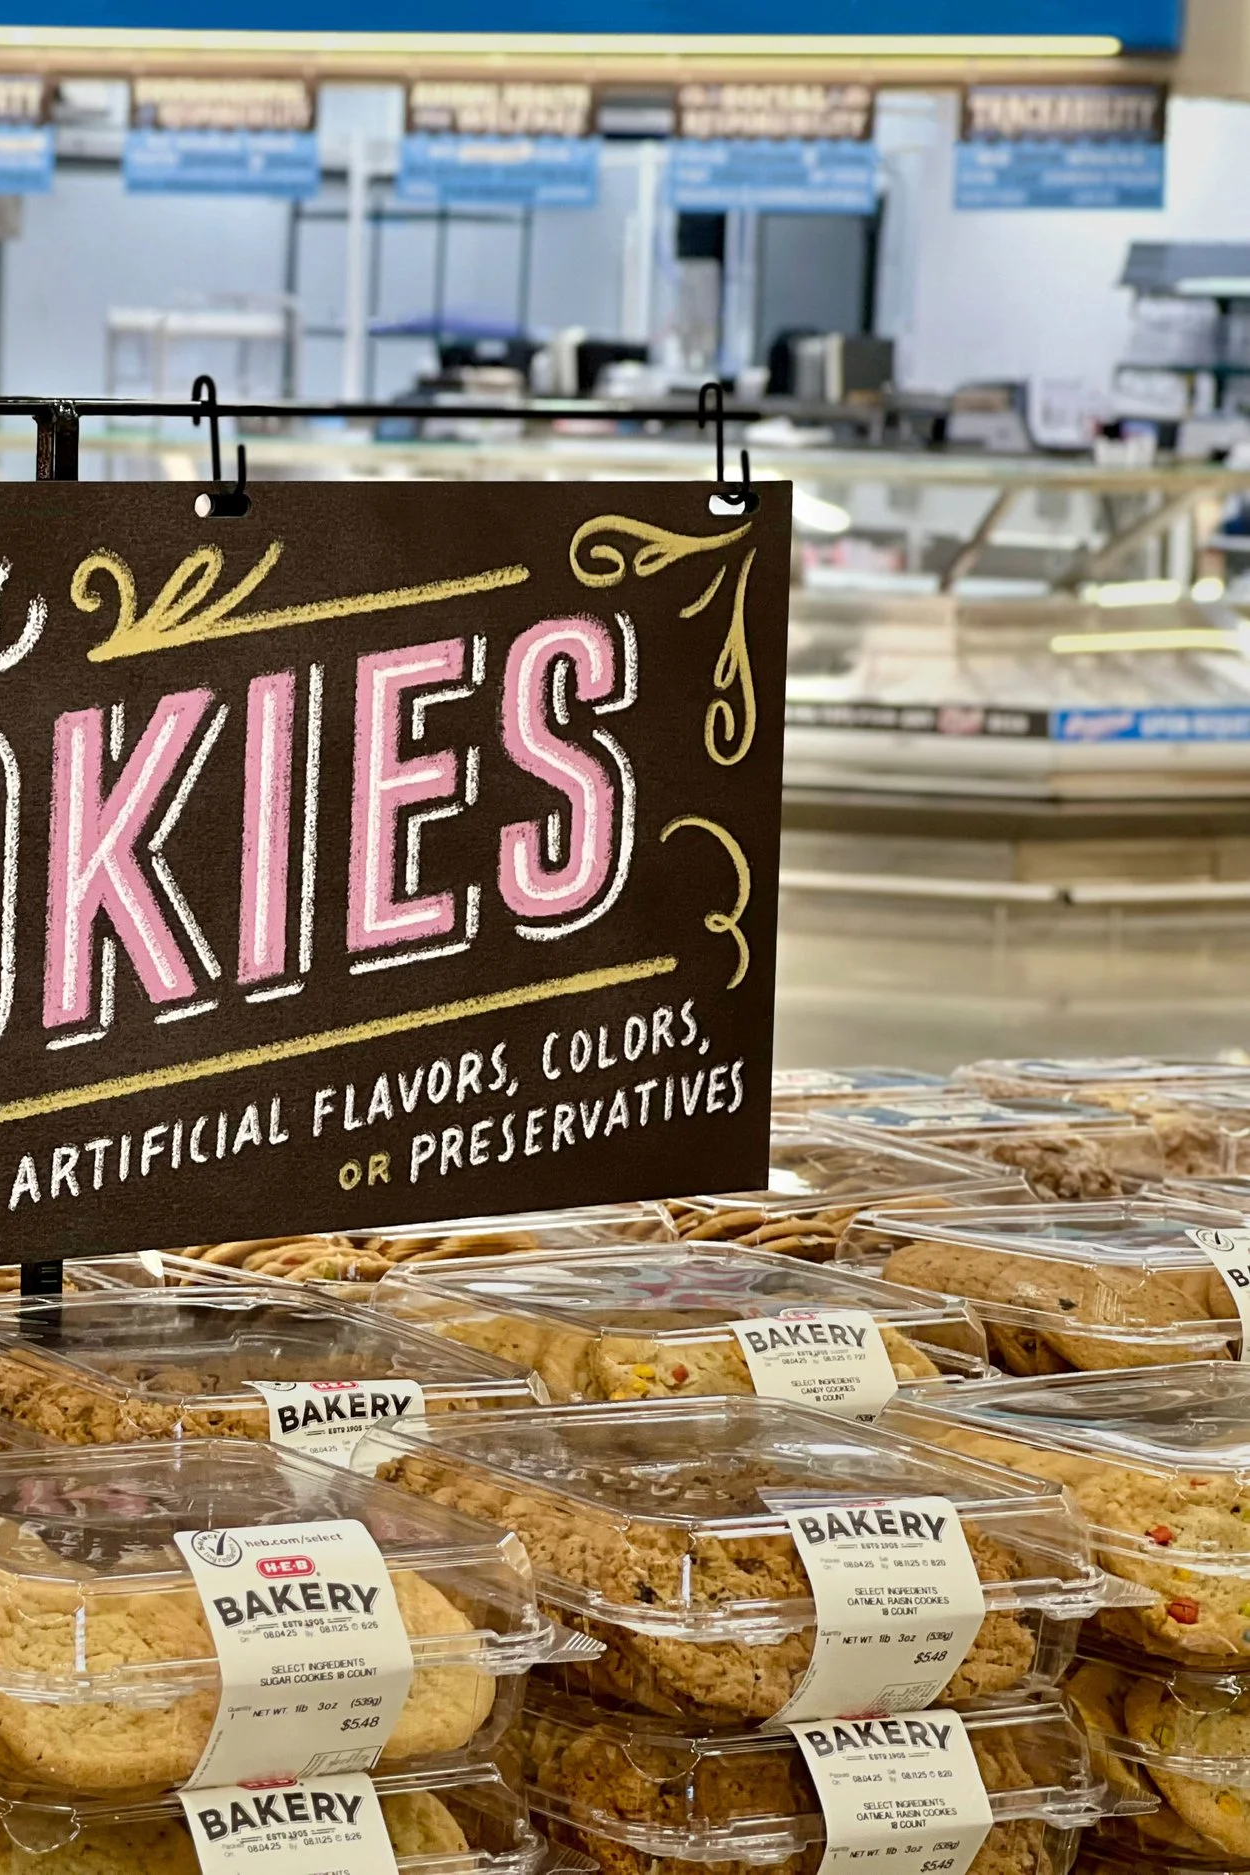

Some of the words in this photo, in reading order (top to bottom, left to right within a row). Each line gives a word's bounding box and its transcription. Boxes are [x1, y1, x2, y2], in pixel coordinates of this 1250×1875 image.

[9, 1094, 291, 1209] ARTIFICIAL
[311, 1041, 520, 1139] FLAVORS,
[541, 998, 711, 1082] COLORS,
[409, 1058, 746, 1186] PRESERVATIVES
[744, 1324, 867, 1355] BAKERY
[818, 1377, 861, 1385] INGREDIENTS
[801, 1386, 823, 1394] CANDY
[826, 1385, 855, 1393] COOKIES
[823, 1394, 845, 1402] COUNT
[277, 1392, 413, 1436] BAKERY
[347, 1425, 362, 1433] 1905
[798, 1509, 947, 1546] BAKERY
[245, 1533, 343, 1548] heb.com/select
[855, 1587, 885, 1595] SELECT
[888, 1587, 938, 1595] INGREDIENTS
[213, 1582, 382, 1628] BAKERY
[847, 1597, 885, 1606] OATMEAL
[888, 1597, 912, 1605] RAISIN
[915, 1596, 949, 1605] COOKIES
[891, 1607, 918, 1615] COUNT
[304, 1618, 324, 1627] 1905
[843, 1636, 858, 1644] NET
[898, 1633, 916, 1642] 3oz
[914, 1650, 948, 1664] $5.48
[272, 1664, 305, 1674] SELECT
[309, 1658, 365, 1670] INGREDIENTS
[260, 1676, 290, 1686] SUGAR
[294, 1672, 333, 1683] COOKIES
[347, 1668, 377, 1678] COUNT
[253, 1709, 270, 1717] NET
[318, 1702, 338, 1711] 3oz
[341, 1716, 380, 1731] $5.48
[805, 1720, 952, 1758] BAKERY
[864, 1800, 893, 1810] SELECT
[895, 1799, 946, 1809] INGREDIENTS
[197, 1792, 364, 1842] BAKERY
[856, 1812, 894, 1821] OATMEAL
[896, 1810, 921, 1818] RAISIN
[923, 1808, 957, 1816] COOKIES
[900, 1820, 926, 1828] COUNT
[850, 1850, 864, 1858] NET
[905, 1845, 923, 1854] 3oz
[920, 1859, 954, 1873] $5.48
